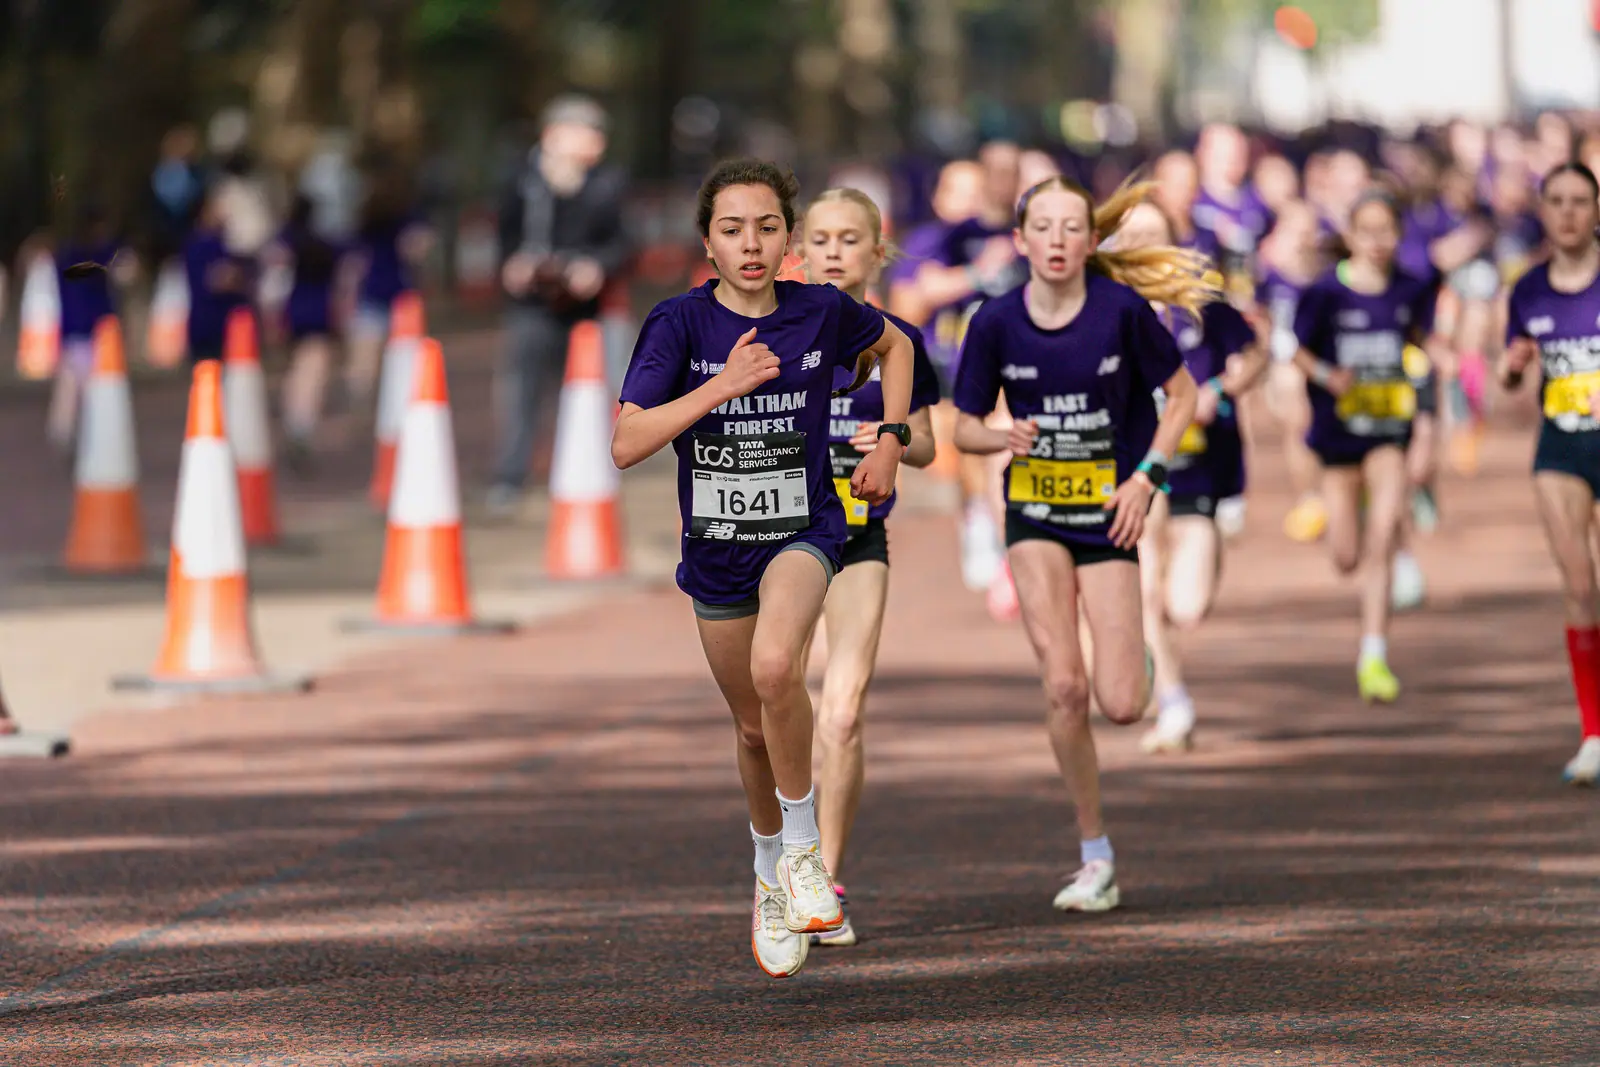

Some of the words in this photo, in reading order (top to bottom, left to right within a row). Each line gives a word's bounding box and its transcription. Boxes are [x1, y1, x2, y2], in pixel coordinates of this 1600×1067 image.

[723, 416, 795, 435] FOREST
[738, 440, 766, 449] TATA
[694, 438, 734, 468] tcs
[738, 447, 800, 459] CONSULTANCY
[738, 457, 778, 469] SERVICES
[1030, 475, 1093, 499] 1834
[717, 488, 780, 516] 1641
[736, 533, 758, 541] new
